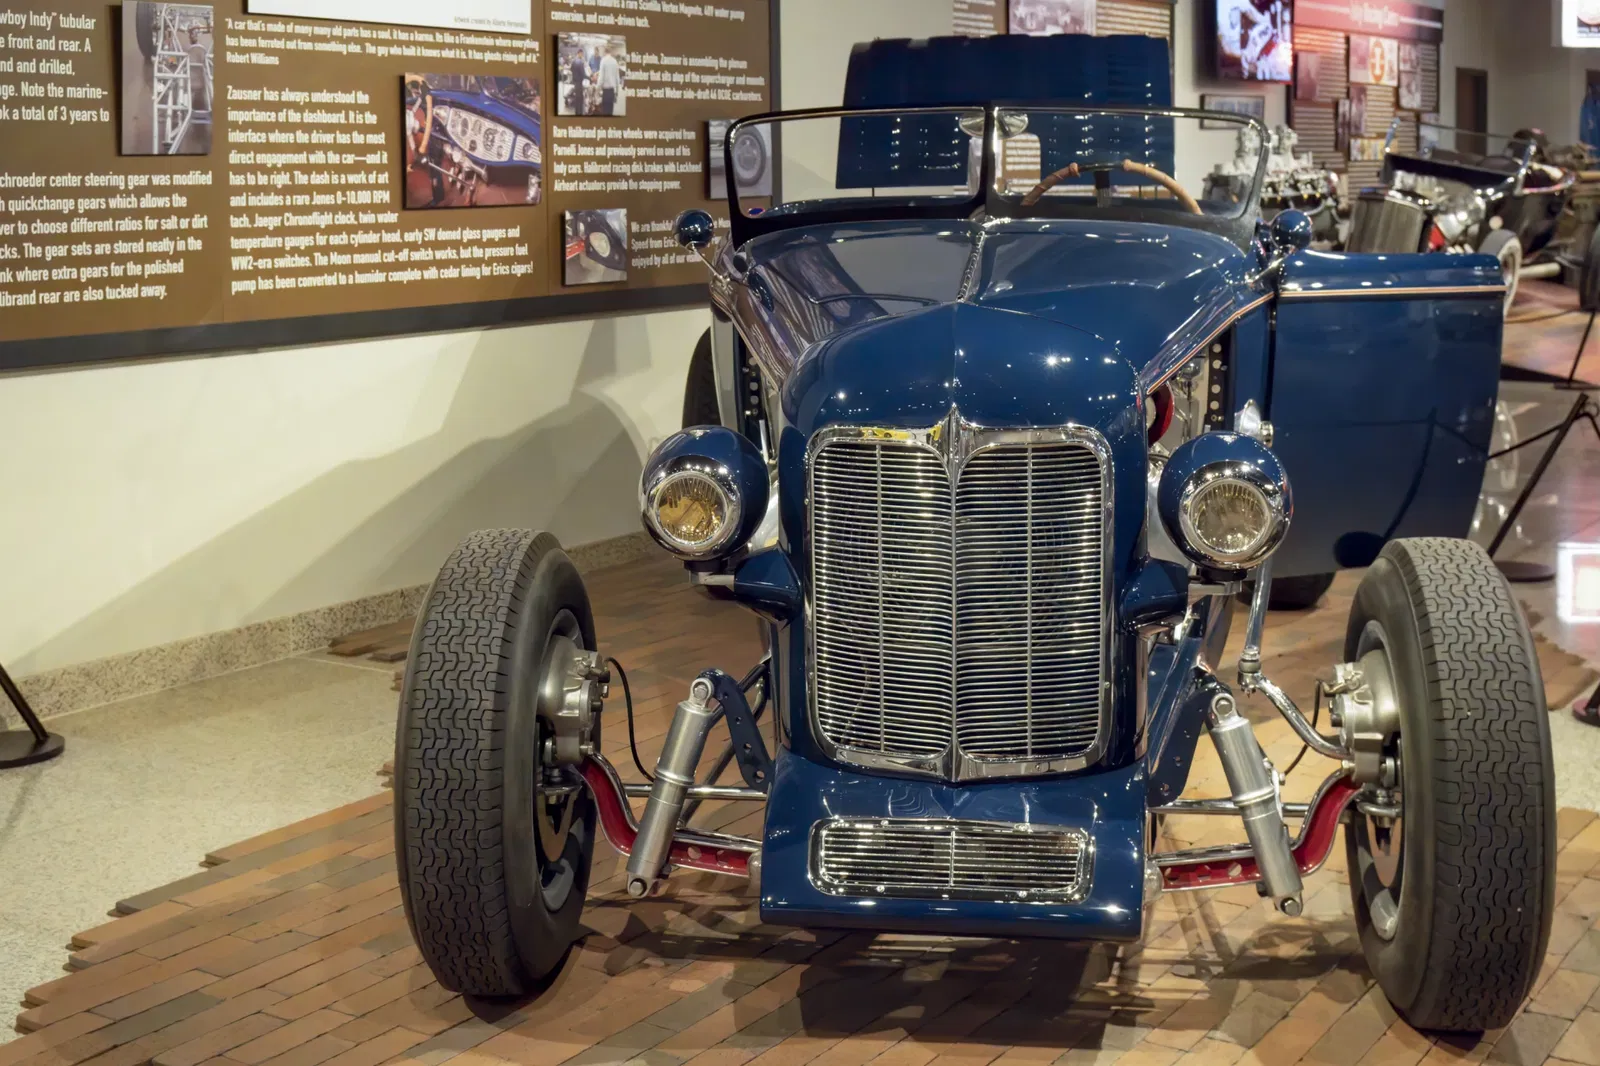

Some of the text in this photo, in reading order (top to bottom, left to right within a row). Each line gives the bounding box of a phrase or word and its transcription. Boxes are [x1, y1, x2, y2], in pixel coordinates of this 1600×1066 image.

[60, 13, 96, 30] tubular
[8, 34, 33, 49] front
[36, 36, 55, 50] and
[59, 40, 81, 52] rear.
[84, 38, 91, 52] A
[0, 57, 13, 72] nd
[17, 59, 36, 73] and
[21, 81, 44, 96] Note
[47, 83, 63, 97] the
[13, 110, 19, 119] a
[22, 106, 45, 120] total
[48, 106, 58, 120] of
[61, 106, 66, 121] 3
[70, 110, 97, 124] years
[100, 108, 109, 122] to
[0, 171, 212, 189] chroeder center steering gear was modified
[9, 193, 187, 215] quickchange gears which allows the
[18, 221, 28, 234] to
[31, 219, 67, 234] choose
[71, 217, 113, 233] different
[115, 216, 142, 231] ratios
[145, 216, 158, 230] for
[160, 215, 177, 230] salt
[180, 217, 190, 229] or
[192, 214, 208, 229] dirt
[0, 236, 202, 261] cks. The gear sets are stored neatly in the
[0, 259, 184, 283] nk where extra gears for the polished
[0, 283, 167, 306] librand rear are also tucked away.
